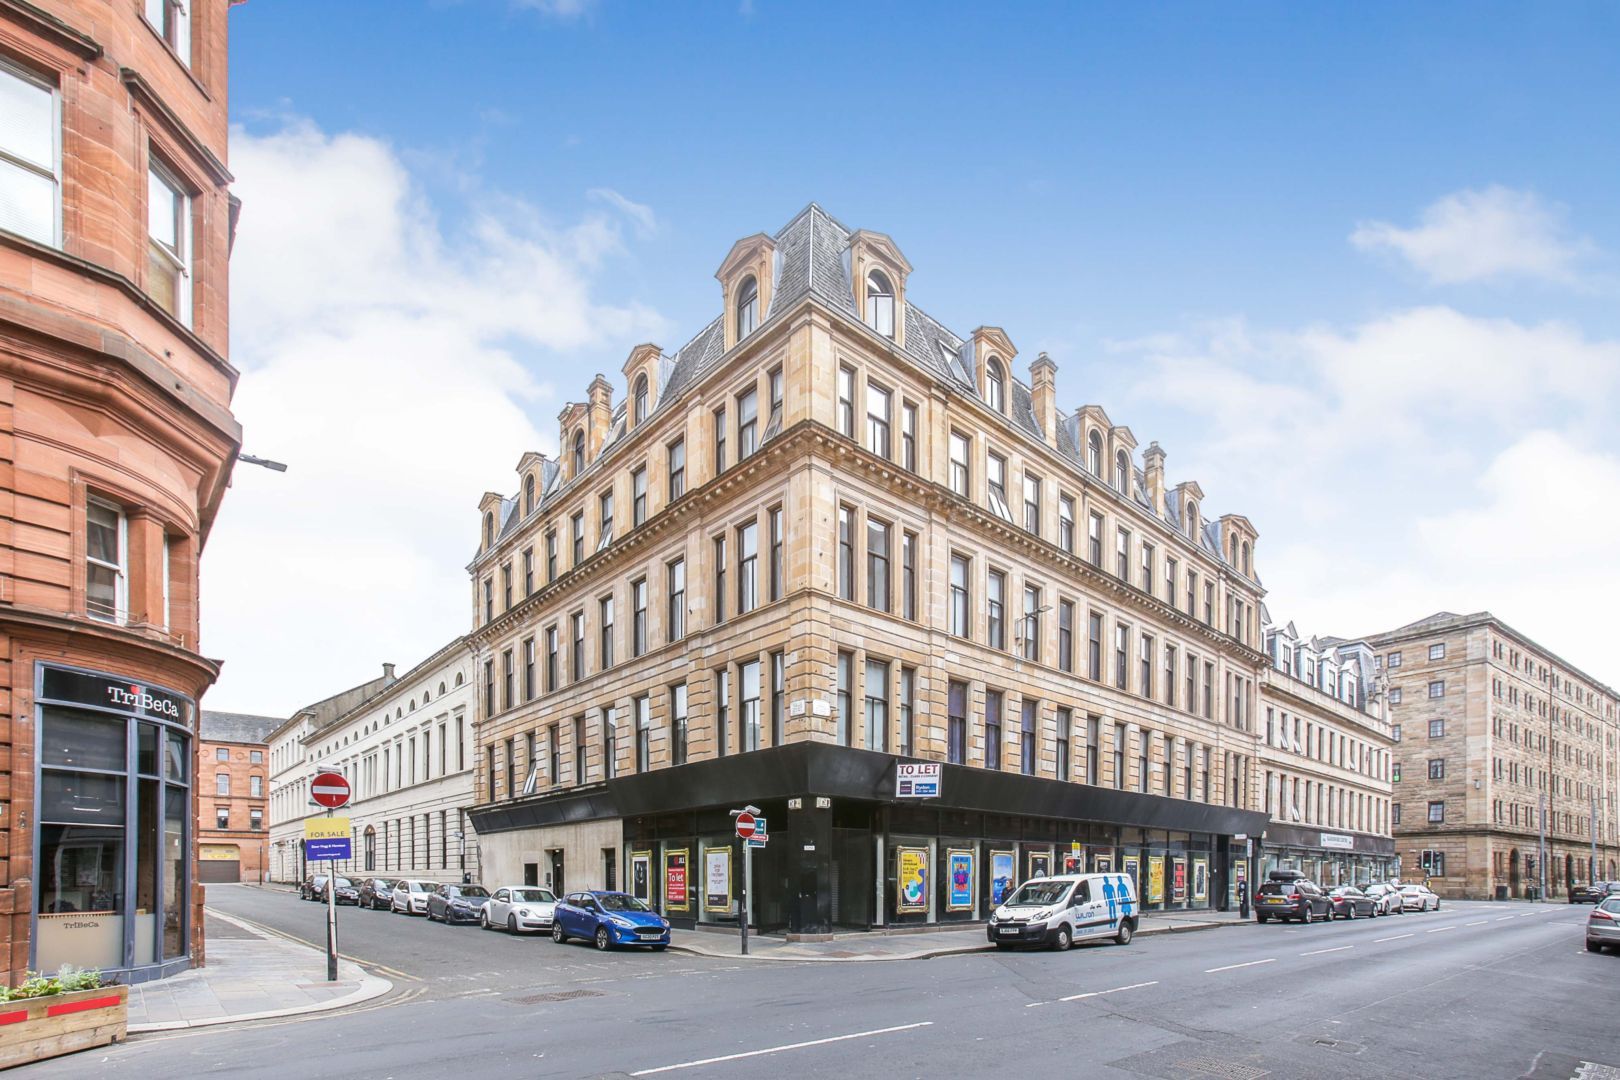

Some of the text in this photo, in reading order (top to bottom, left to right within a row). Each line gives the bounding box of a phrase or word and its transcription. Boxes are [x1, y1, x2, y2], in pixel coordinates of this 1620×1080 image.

[107, 684, 179, 717] TriBeCa
[899, 764, 938, 775] TO LET
[668, 872, 684, 882] To let
